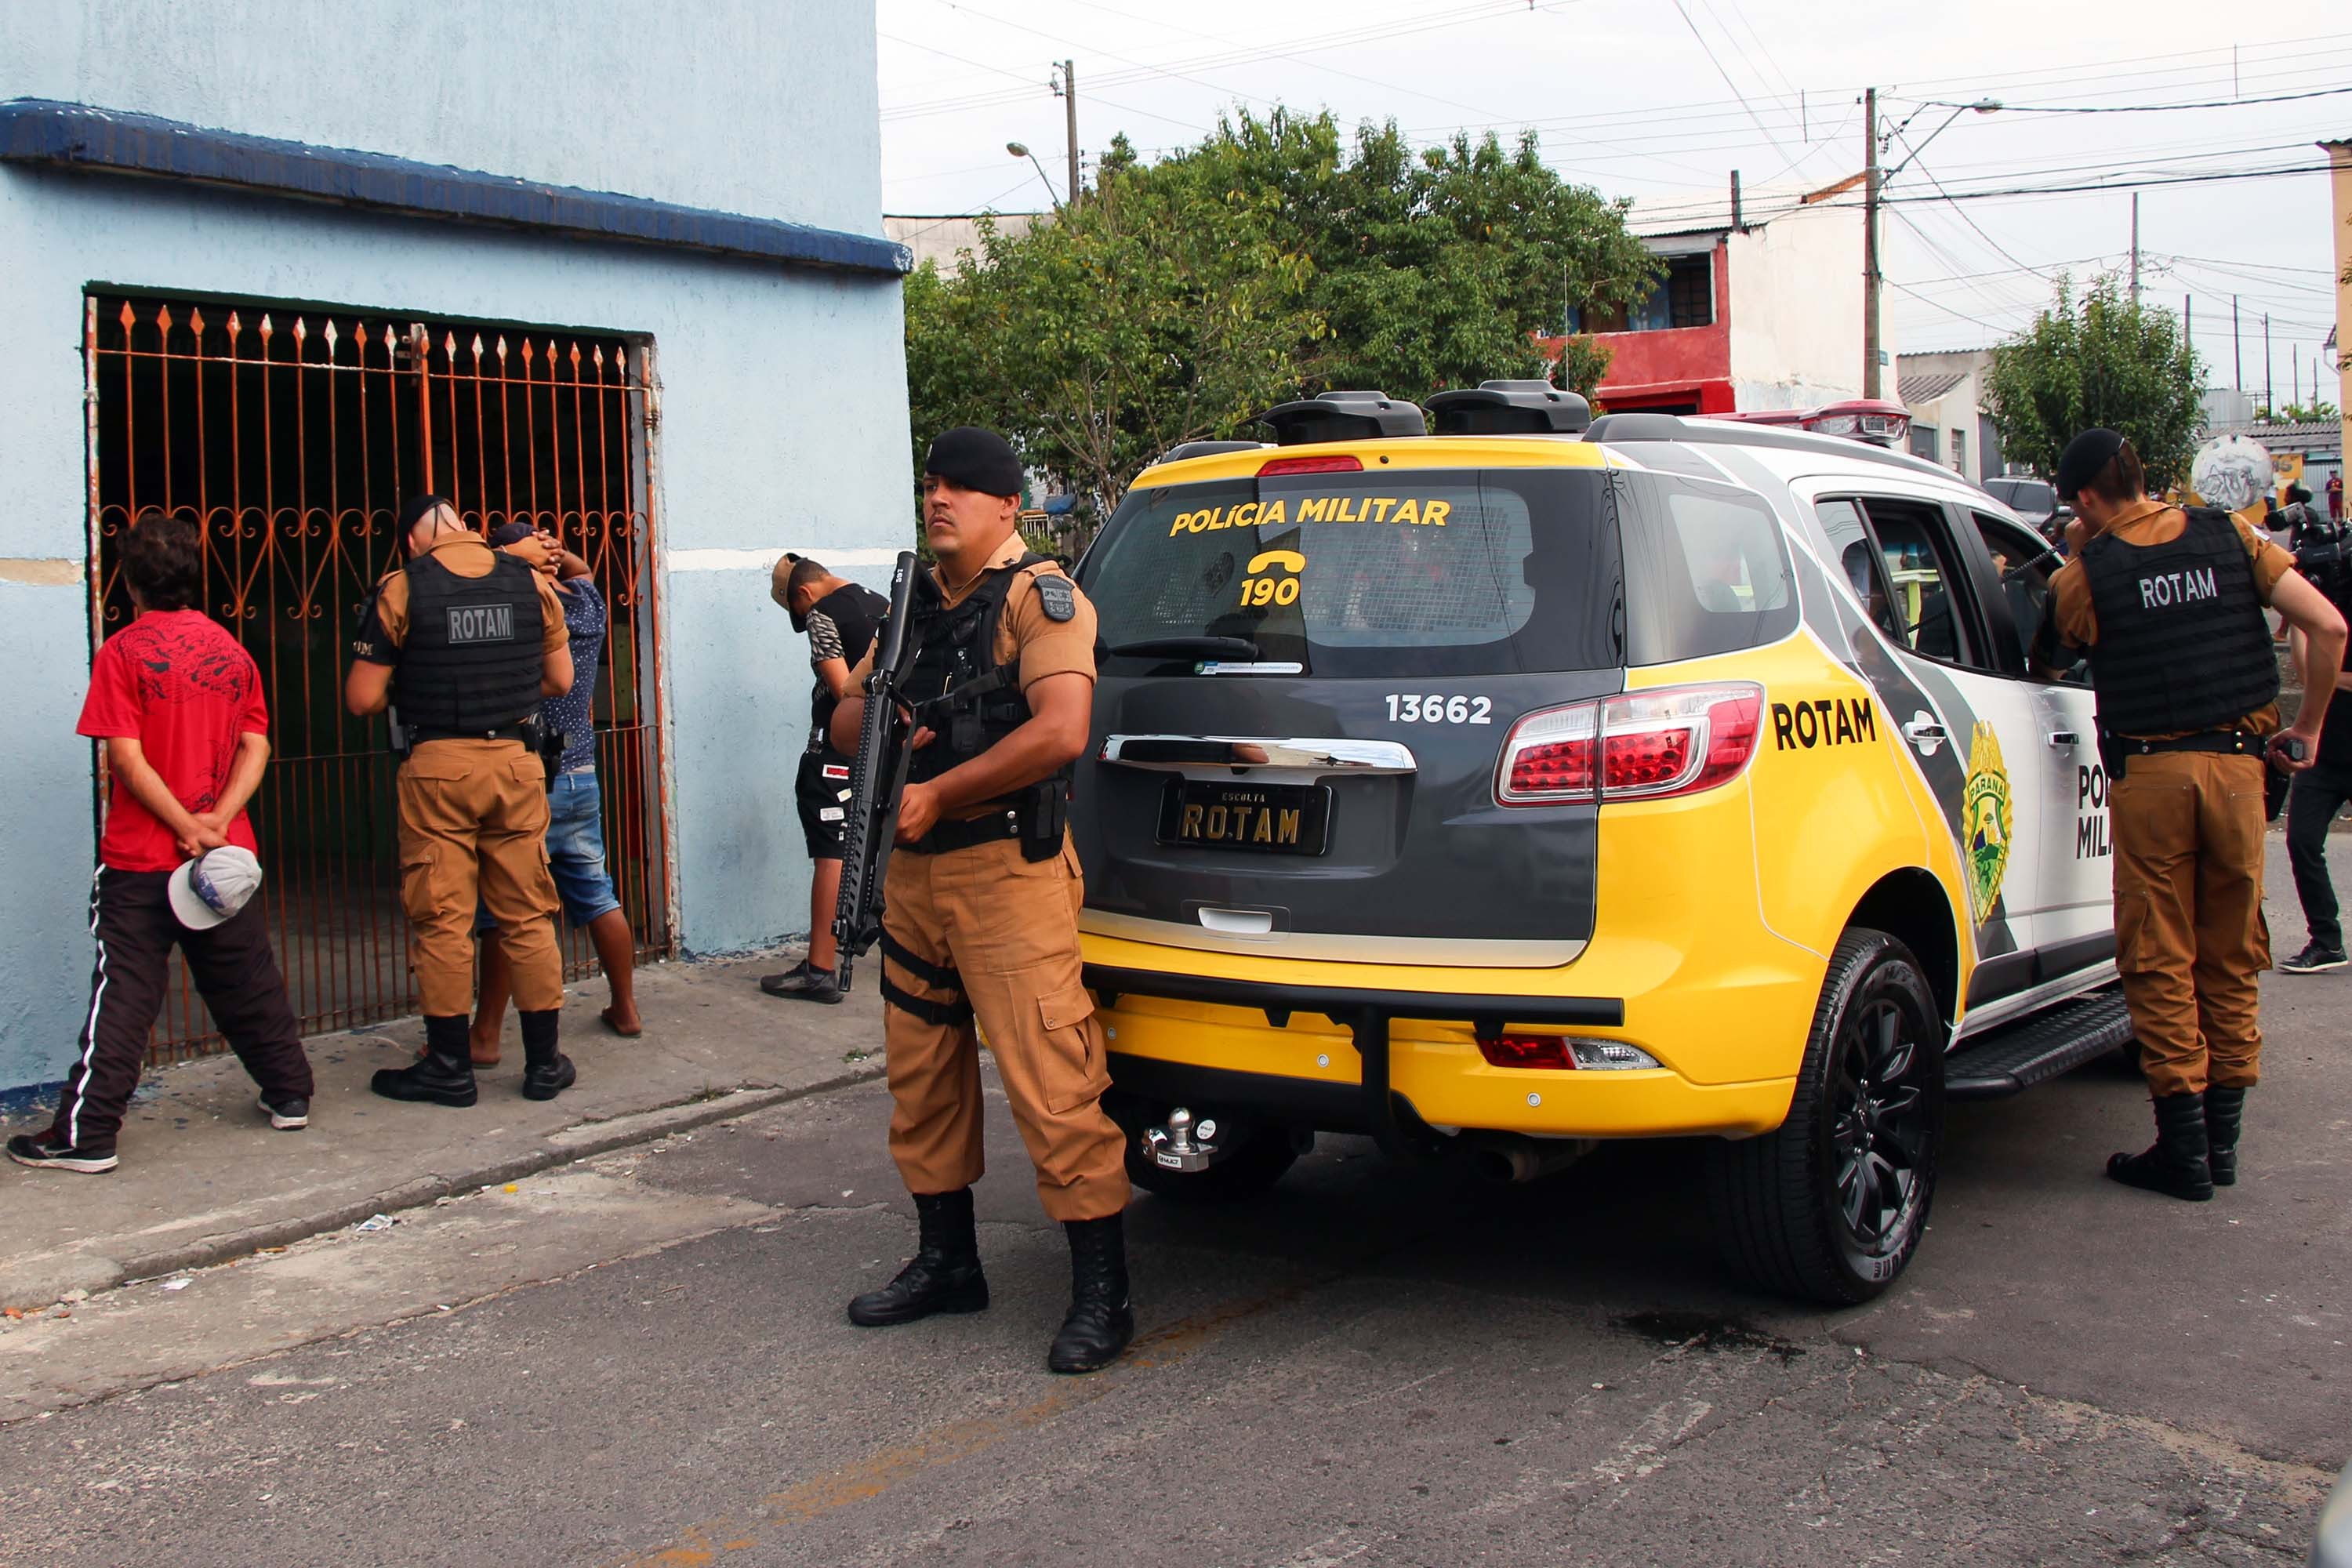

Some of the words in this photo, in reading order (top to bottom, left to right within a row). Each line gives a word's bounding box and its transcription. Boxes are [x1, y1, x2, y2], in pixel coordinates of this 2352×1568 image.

[1296, 498, 1451, 526] MILITAR
[1240, 578, 1300, 606] 190
[2139, 567, 2217, 608] ROTAM
[450, 608, 510, 639] ROTAM
[1385, 694, 1491, 724] 13662
[1771, 698, 1876, 750] ROTAM
[1222, 793, 1265, 802] ESCOLTA
[1181, 804, 1299, 844] ROTAM
